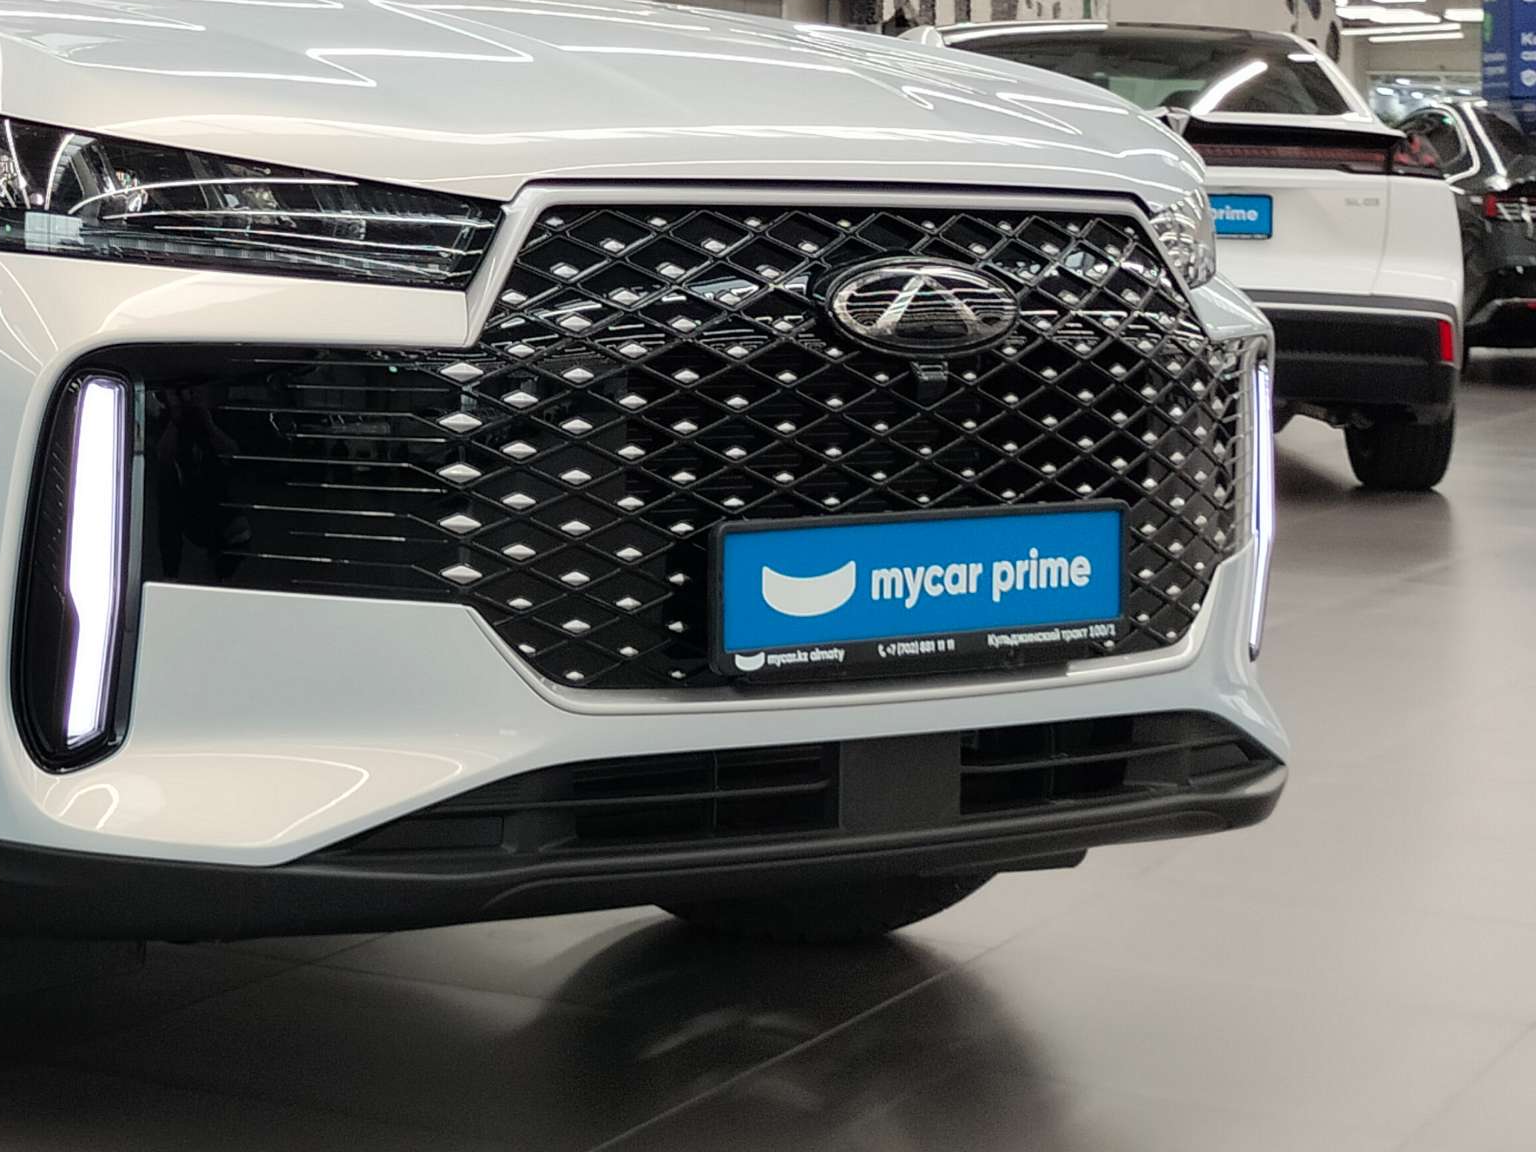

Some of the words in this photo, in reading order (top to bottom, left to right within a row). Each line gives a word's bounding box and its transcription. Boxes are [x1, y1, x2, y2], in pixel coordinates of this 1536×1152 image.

[871, 562, 983, 609] mycar
[992, 547, 1092, 603] prime
[810, 647, 845, 663] almaty
